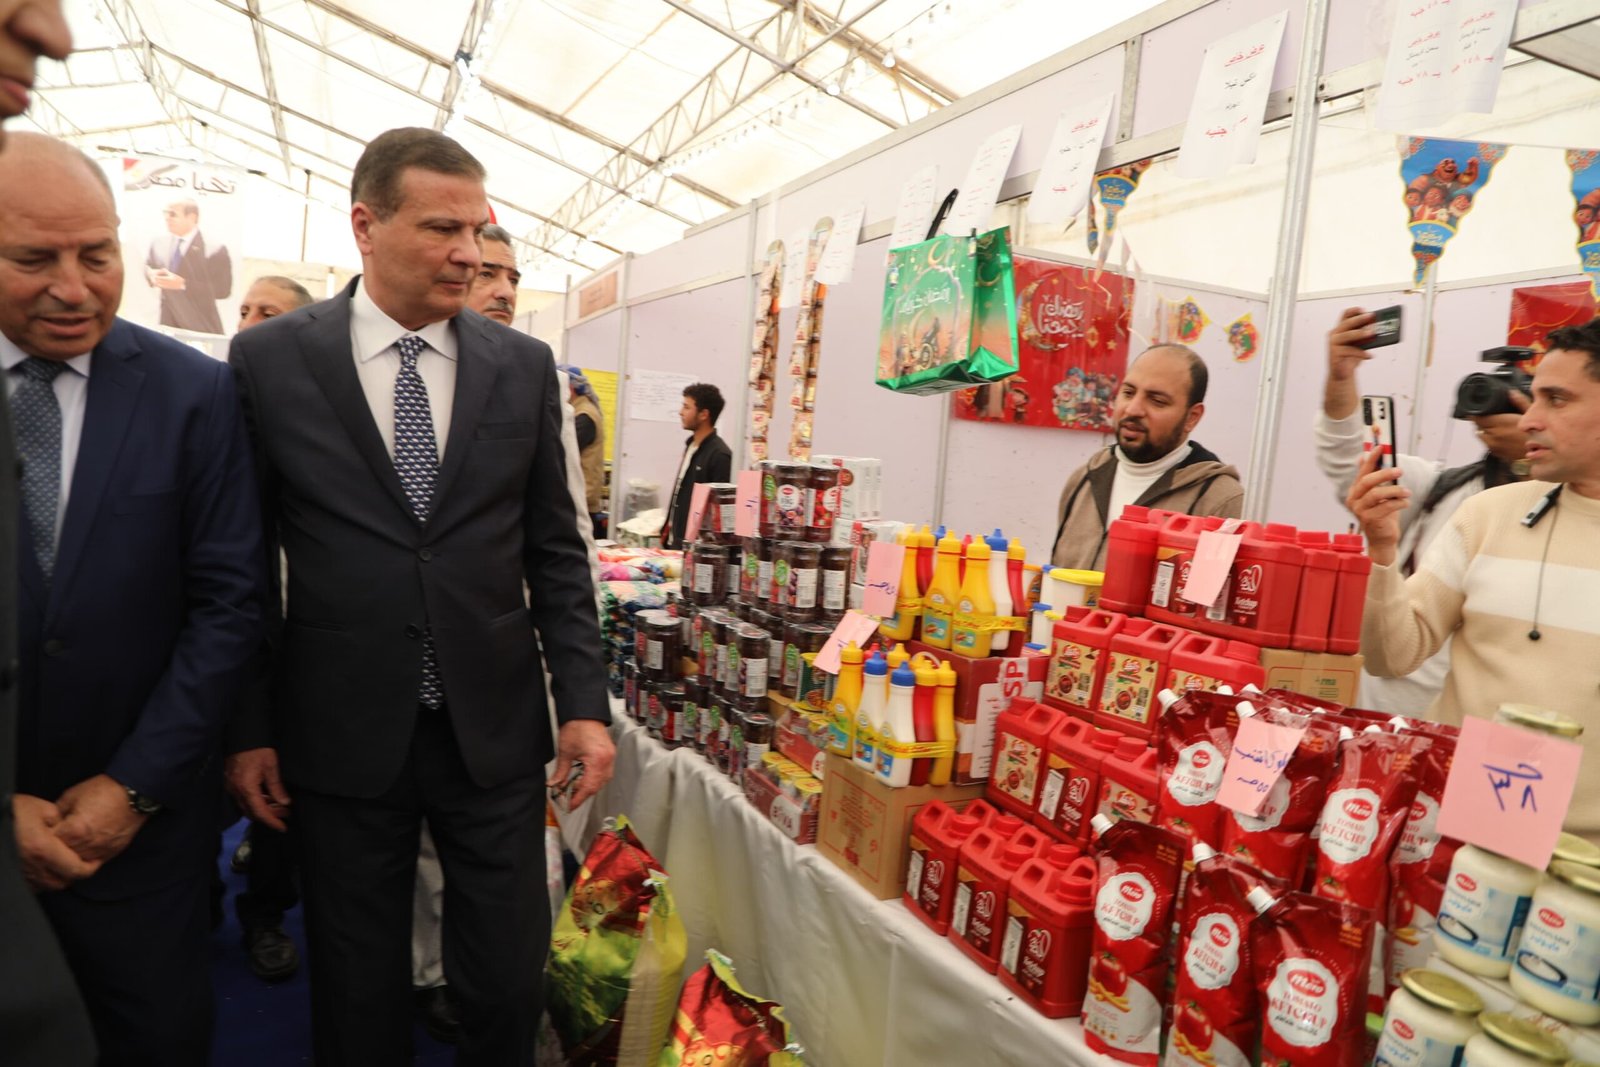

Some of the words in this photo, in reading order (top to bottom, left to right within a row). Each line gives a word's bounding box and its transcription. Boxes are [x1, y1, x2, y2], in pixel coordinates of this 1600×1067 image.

[140, 176, 186, 191] مصر
[193, 172, 237, 197] تحيا
[1270, 997, 1328, 1030] KETCHUP
